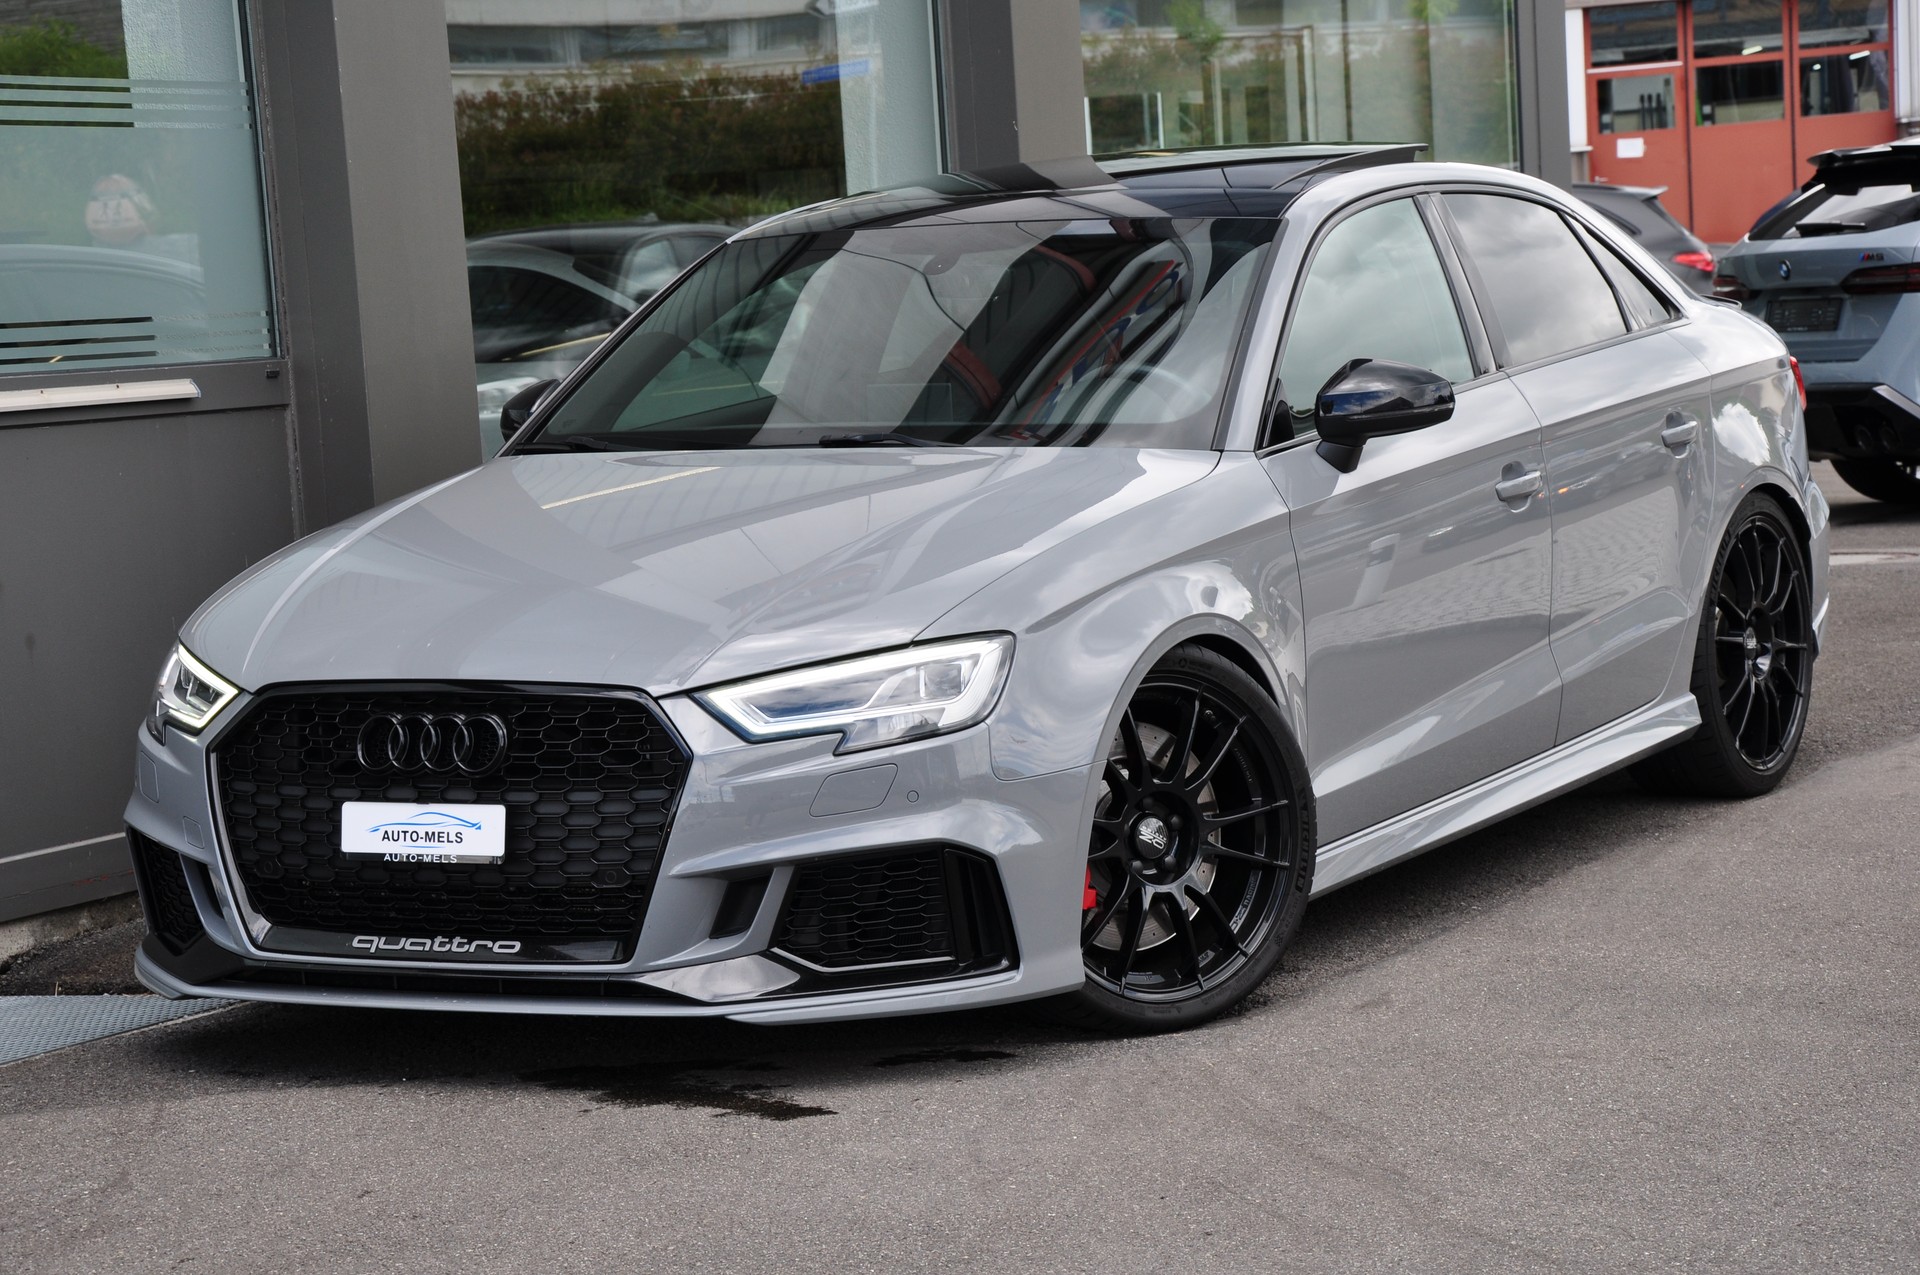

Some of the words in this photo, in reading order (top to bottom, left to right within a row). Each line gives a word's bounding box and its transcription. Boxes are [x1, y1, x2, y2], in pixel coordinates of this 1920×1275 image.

[381, 829, 464, 844] AUTO-MELS
[383, 853, 458, 863] AUTO-MELS
[352, 935, 521, 954] quattro
